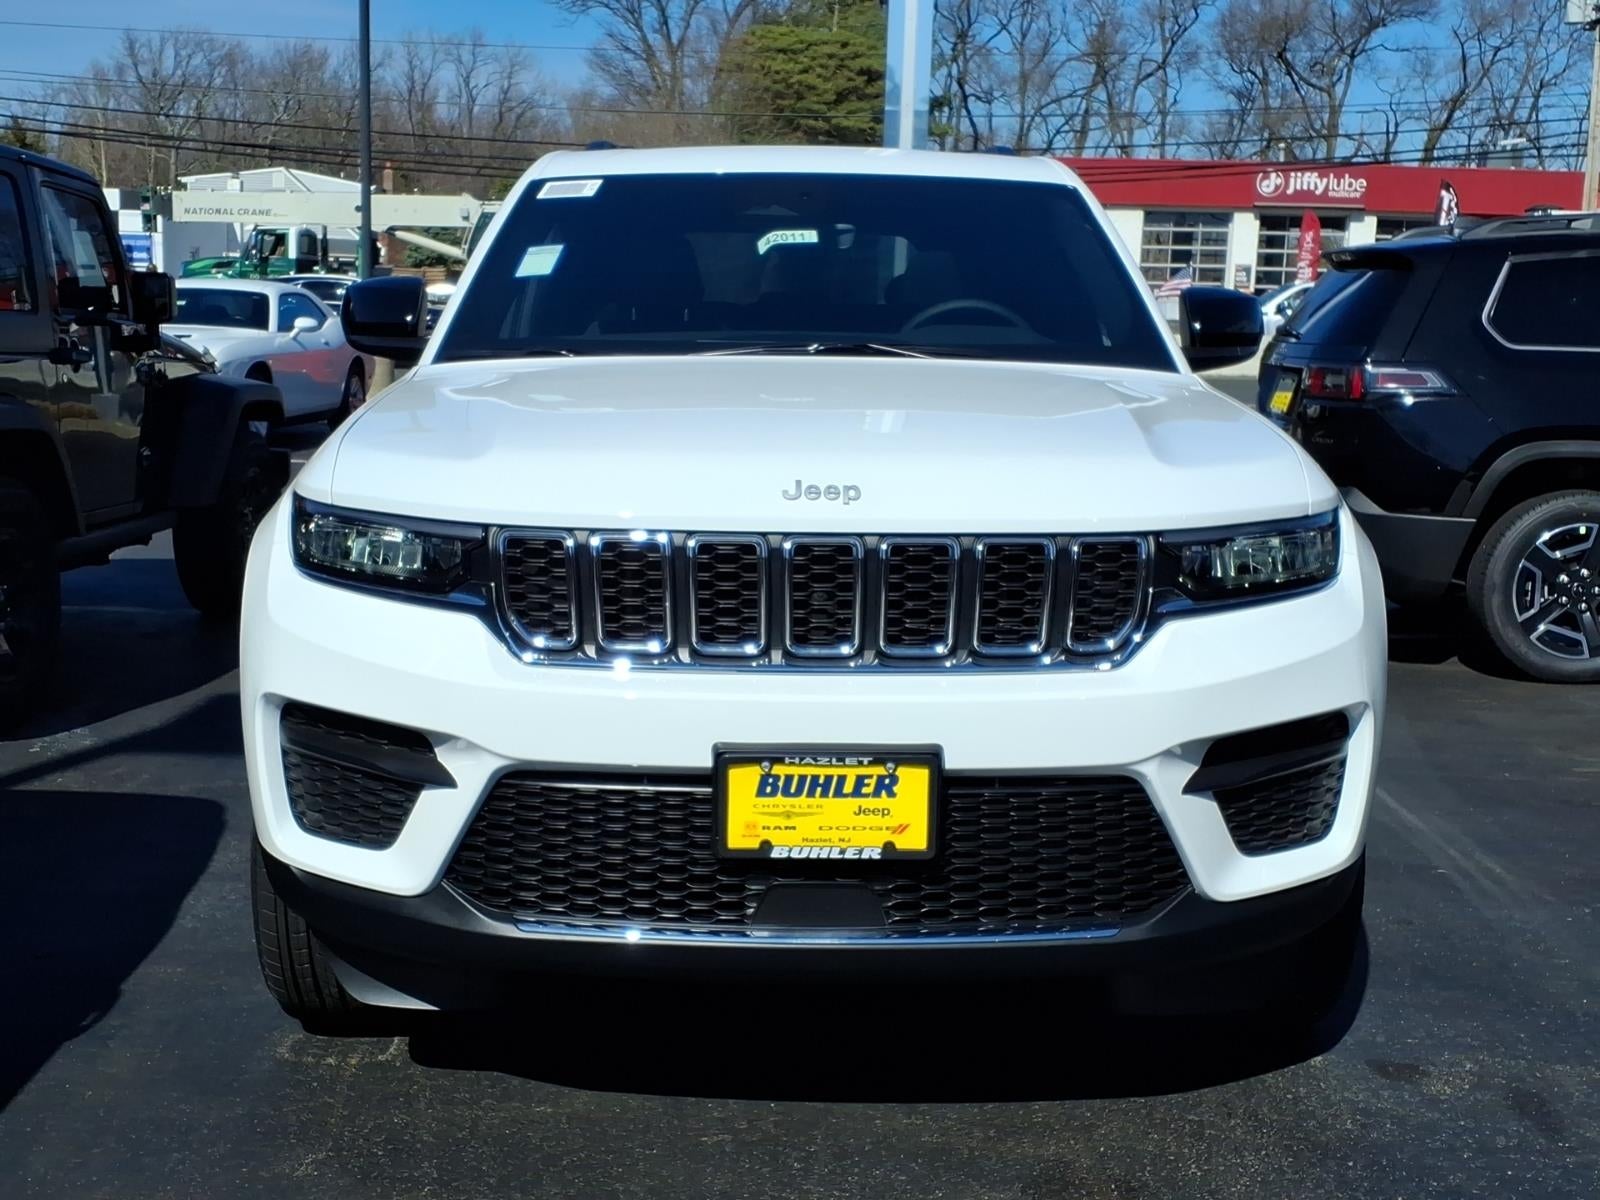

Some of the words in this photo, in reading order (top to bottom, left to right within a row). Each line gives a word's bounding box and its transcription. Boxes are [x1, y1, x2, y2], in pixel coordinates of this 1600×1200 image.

[1286, 172, 1328, 195] jiffy
[1329, 173, 1368, 191] lube
[184, 208, 235, 216] NATIONAL
[237, 208, 272, 217] CRANE
[782, 479, 861, 505] Jeep
[784, 757, 873, 765] HAZLET
[755, 773, 899, 798] BUHLER
[853, 805, 891, 818] Jeep
[770, 846, 883, 859] BUHLER
